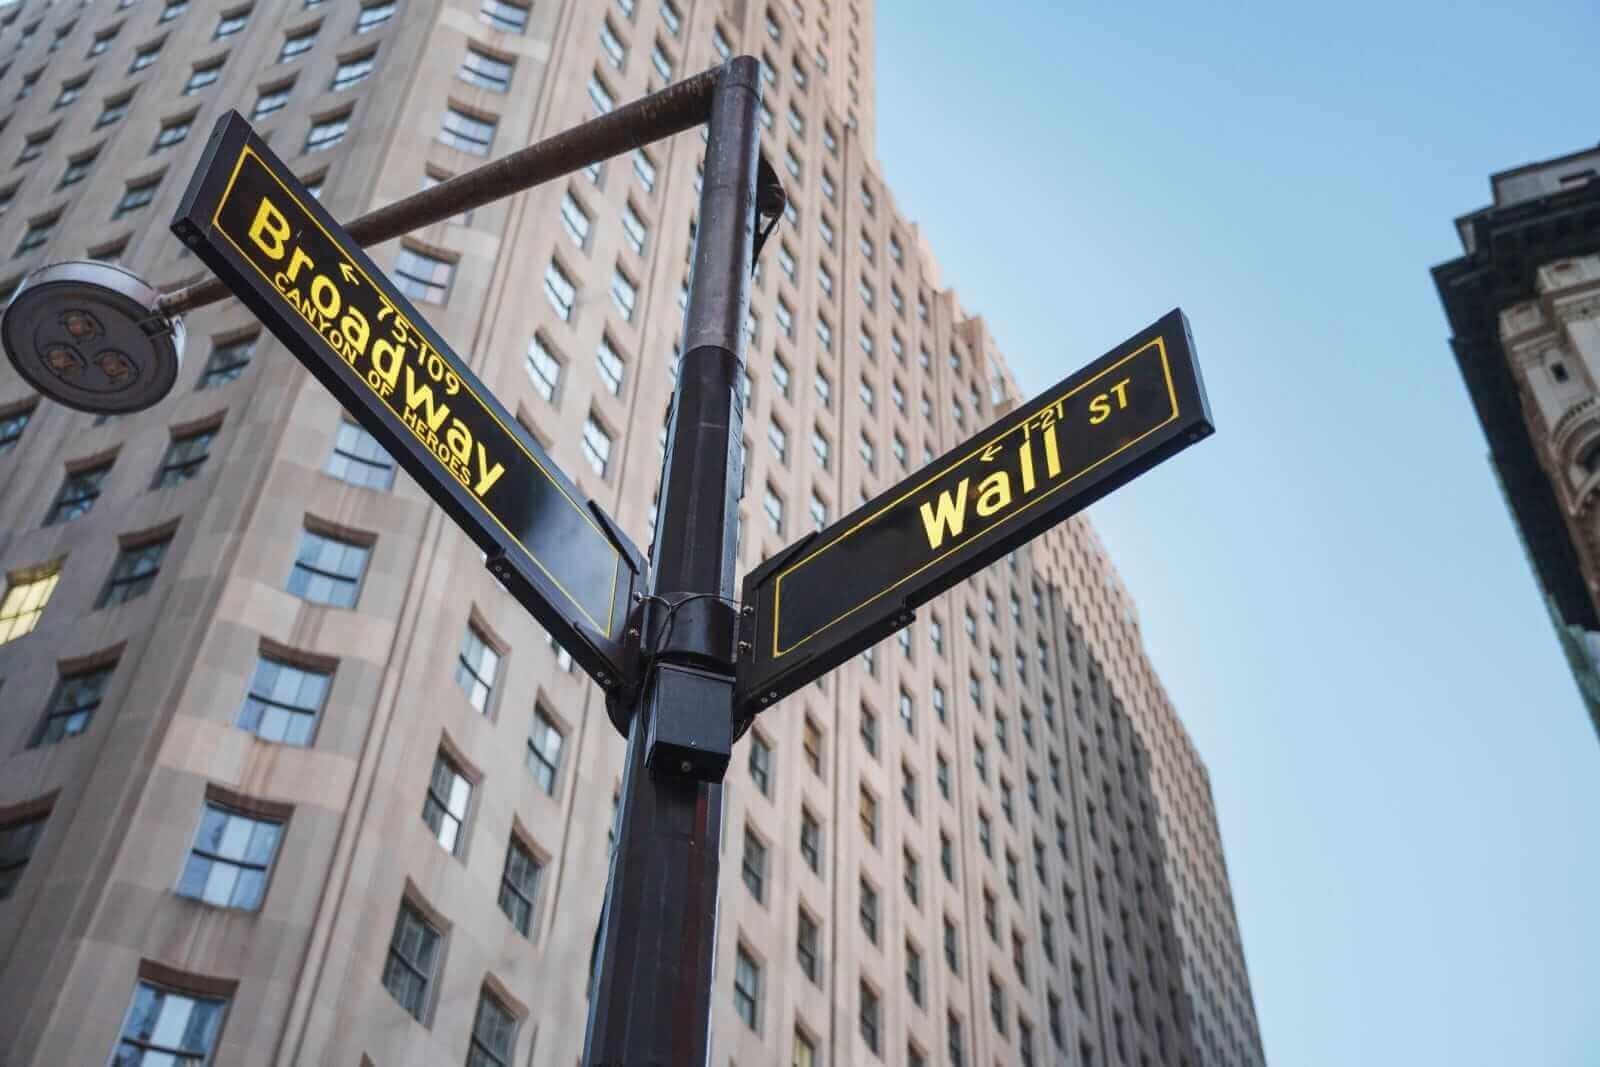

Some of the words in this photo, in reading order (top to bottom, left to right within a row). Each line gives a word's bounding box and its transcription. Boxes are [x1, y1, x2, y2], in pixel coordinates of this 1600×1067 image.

[248, 197, 506, 496] Broadway
[274, 271, 358, 363] CANYON
[367, 372, 394, 397] OF
[402, 405, 473, 485] HEROES
[375, 296, 461, 395] 75-109
[1021, 401, 1065, 441] 1-21
[919, 424, 1062, 550] Wall
[1088, 378, 1131, 425] ST
